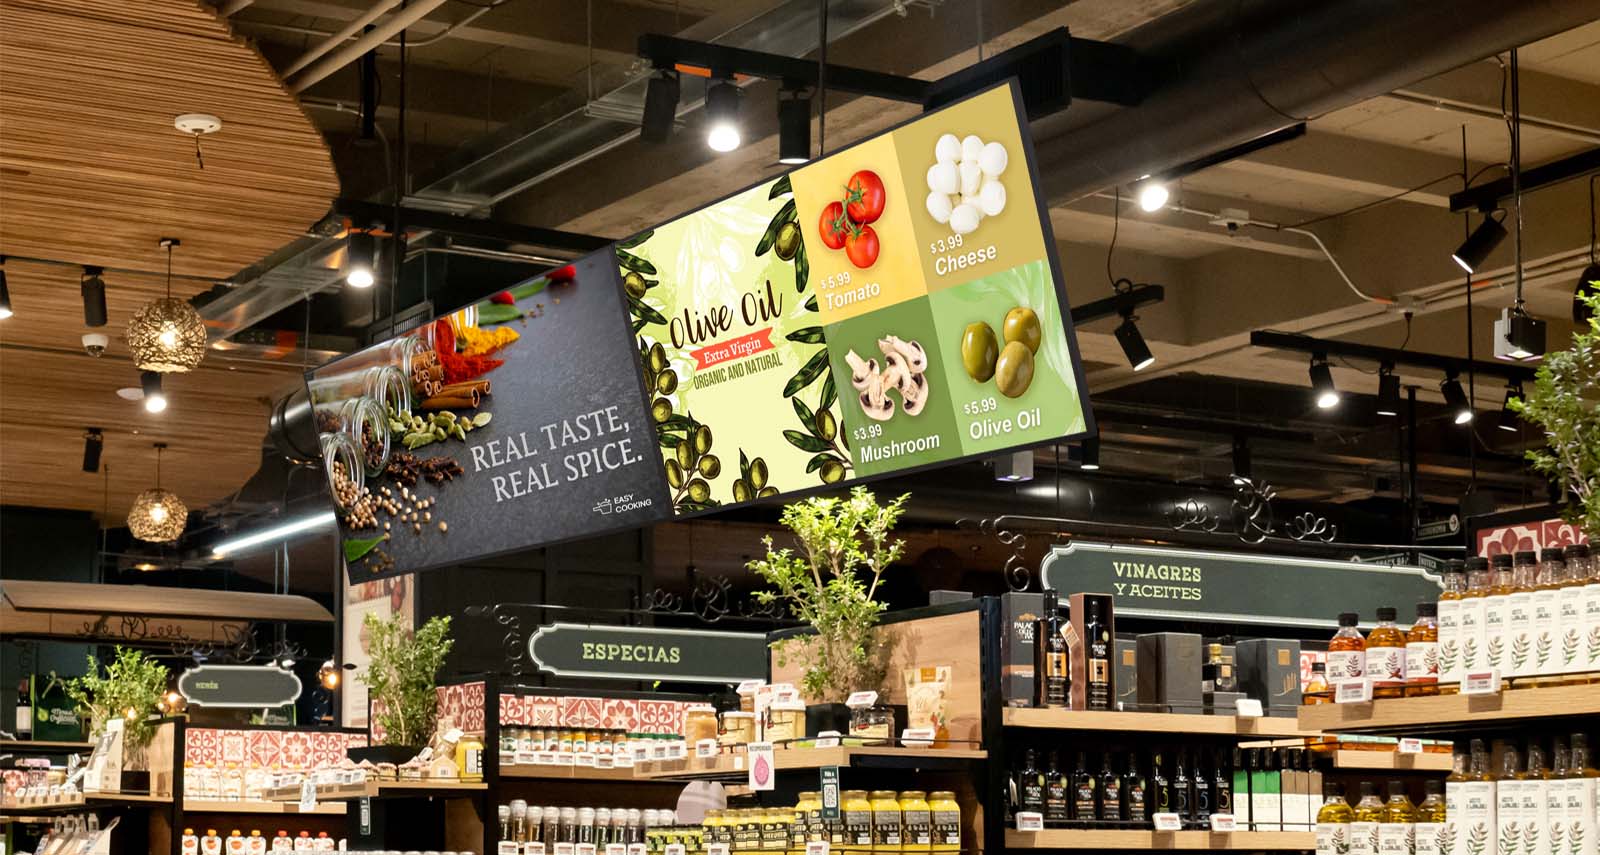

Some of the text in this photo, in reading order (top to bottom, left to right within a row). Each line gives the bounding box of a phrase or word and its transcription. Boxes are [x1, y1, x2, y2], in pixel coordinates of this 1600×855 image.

[935, 245, 997, 276] Cheese
[825, 282, 880, 310] Tomato
[670, 280, 782, 349] Olive Oil
[704, 338, 762, 364] Extra Virgin
[693, 352, 783, 389] ORGANIC AND NATURAL
[964, 397, 997, 415] $5.99
[853, 424, 883, 441] $3.99
[969, 407, 1041, 440] Olive Oil
[470, 405, 630, 472] REAL TASTE,
[860, 434, 940, 464] Mushroom
[491, 438, 643, 503] REAL SPICE.
[614, 493, 634, 504] EASY
[616, 499, 652, 513] COOKING
[1113, 562, 1201, 582] VINAGRES
[1114, 583, 1201, 600] Y ACEITES
[583, 643, 680, 663] ESPECIAS
